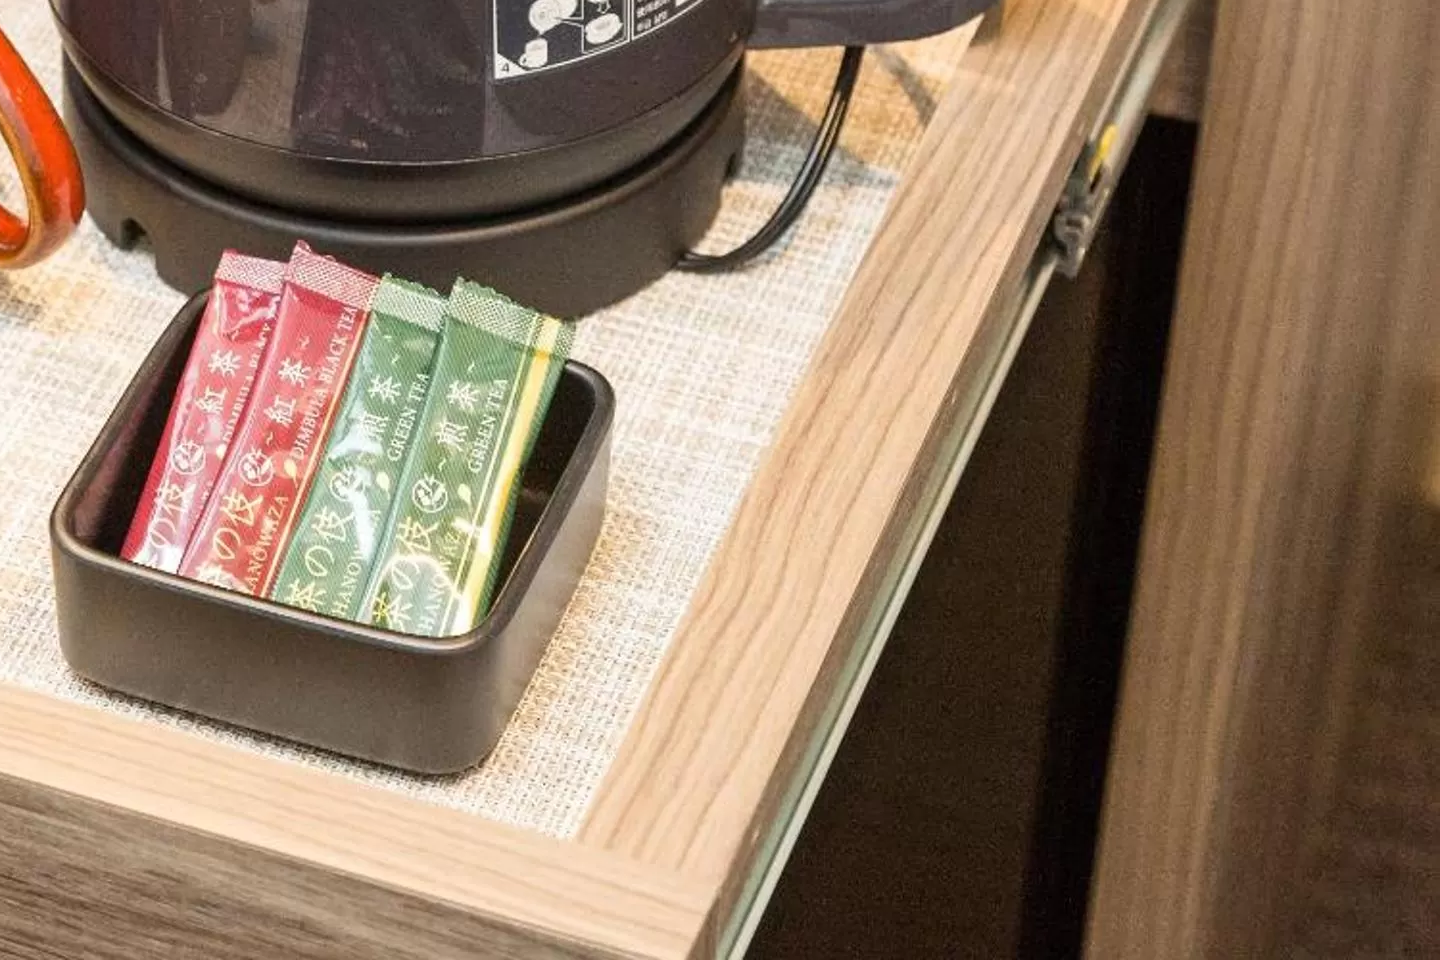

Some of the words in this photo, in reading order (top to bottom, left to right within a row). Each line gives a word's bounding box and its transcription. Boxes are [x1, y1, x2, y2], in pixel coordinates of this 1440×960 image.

[501, 62, 511, 73] 4
[291, 388, 330, 461] DIMBULA
[317, 336, 349, 386] BLACK
[337, 304, 359, 333] TEA
[387, 406, 418, 462] GREEN
[409, 373, 430, 402] TEA
[468, 413, 497, 473] GREEN
[485, 380, 509, 409] TEA
